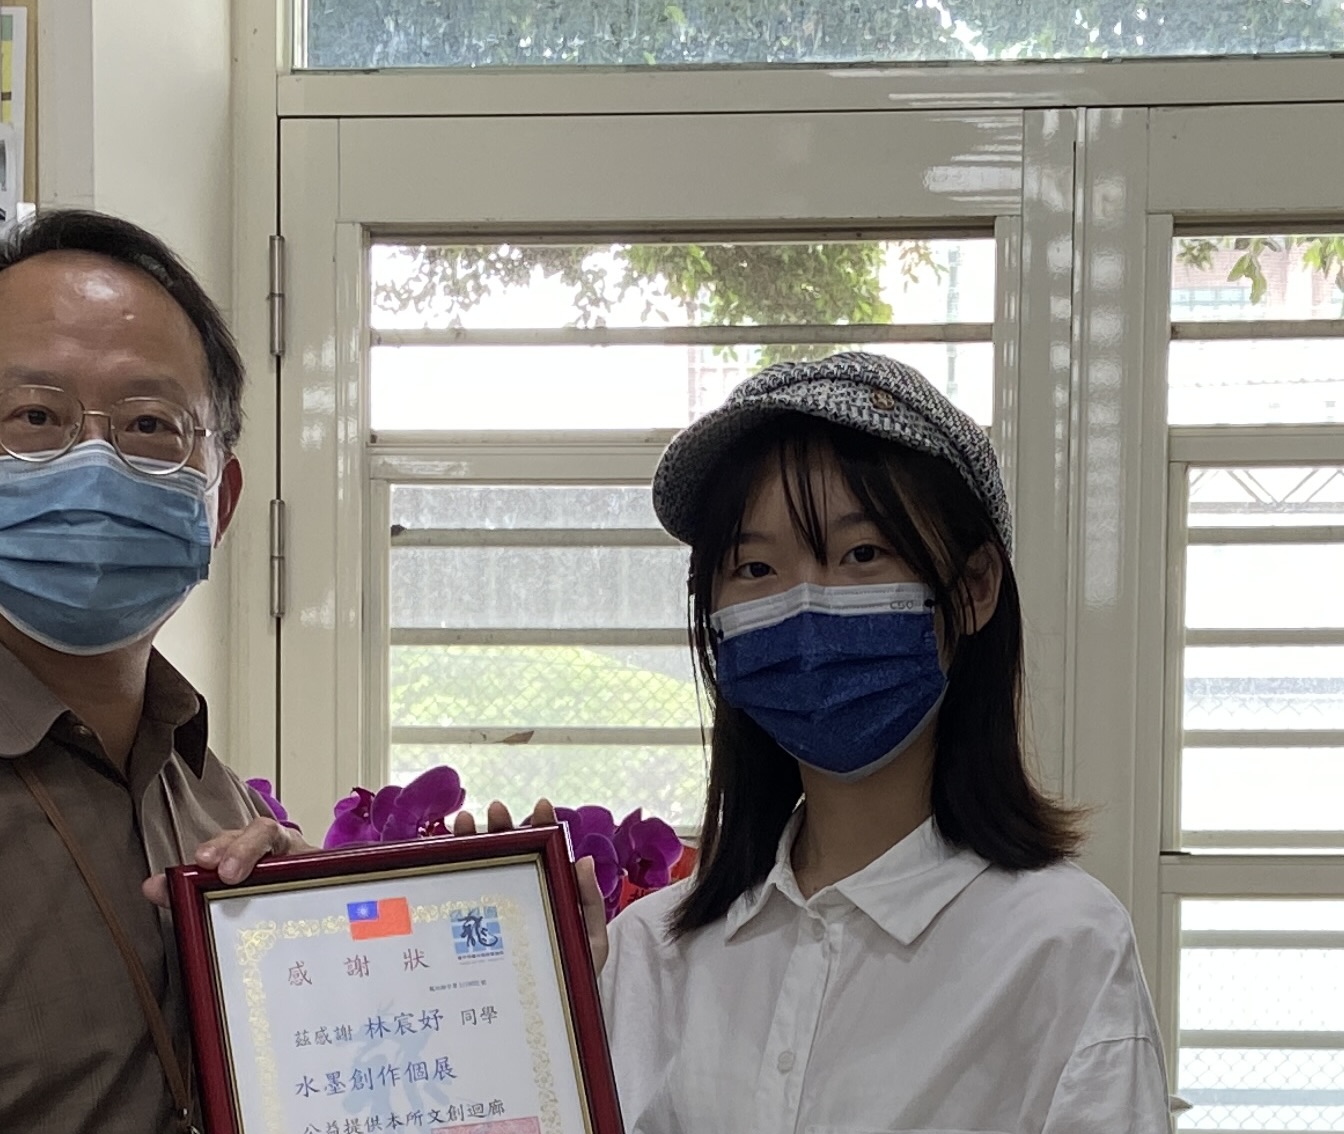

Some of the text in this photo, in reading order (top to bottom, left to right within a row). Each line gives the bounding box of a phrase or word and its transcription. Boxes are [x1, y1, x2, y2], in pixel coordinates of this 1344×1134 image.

[288, 949, 430, 986] 感謝狀
[365, 1009, 444, 1040] 林宸妤
[461, 1006, 497, 1027] 同學
[296, 1056, 457, 1097] 水墨創作個展
